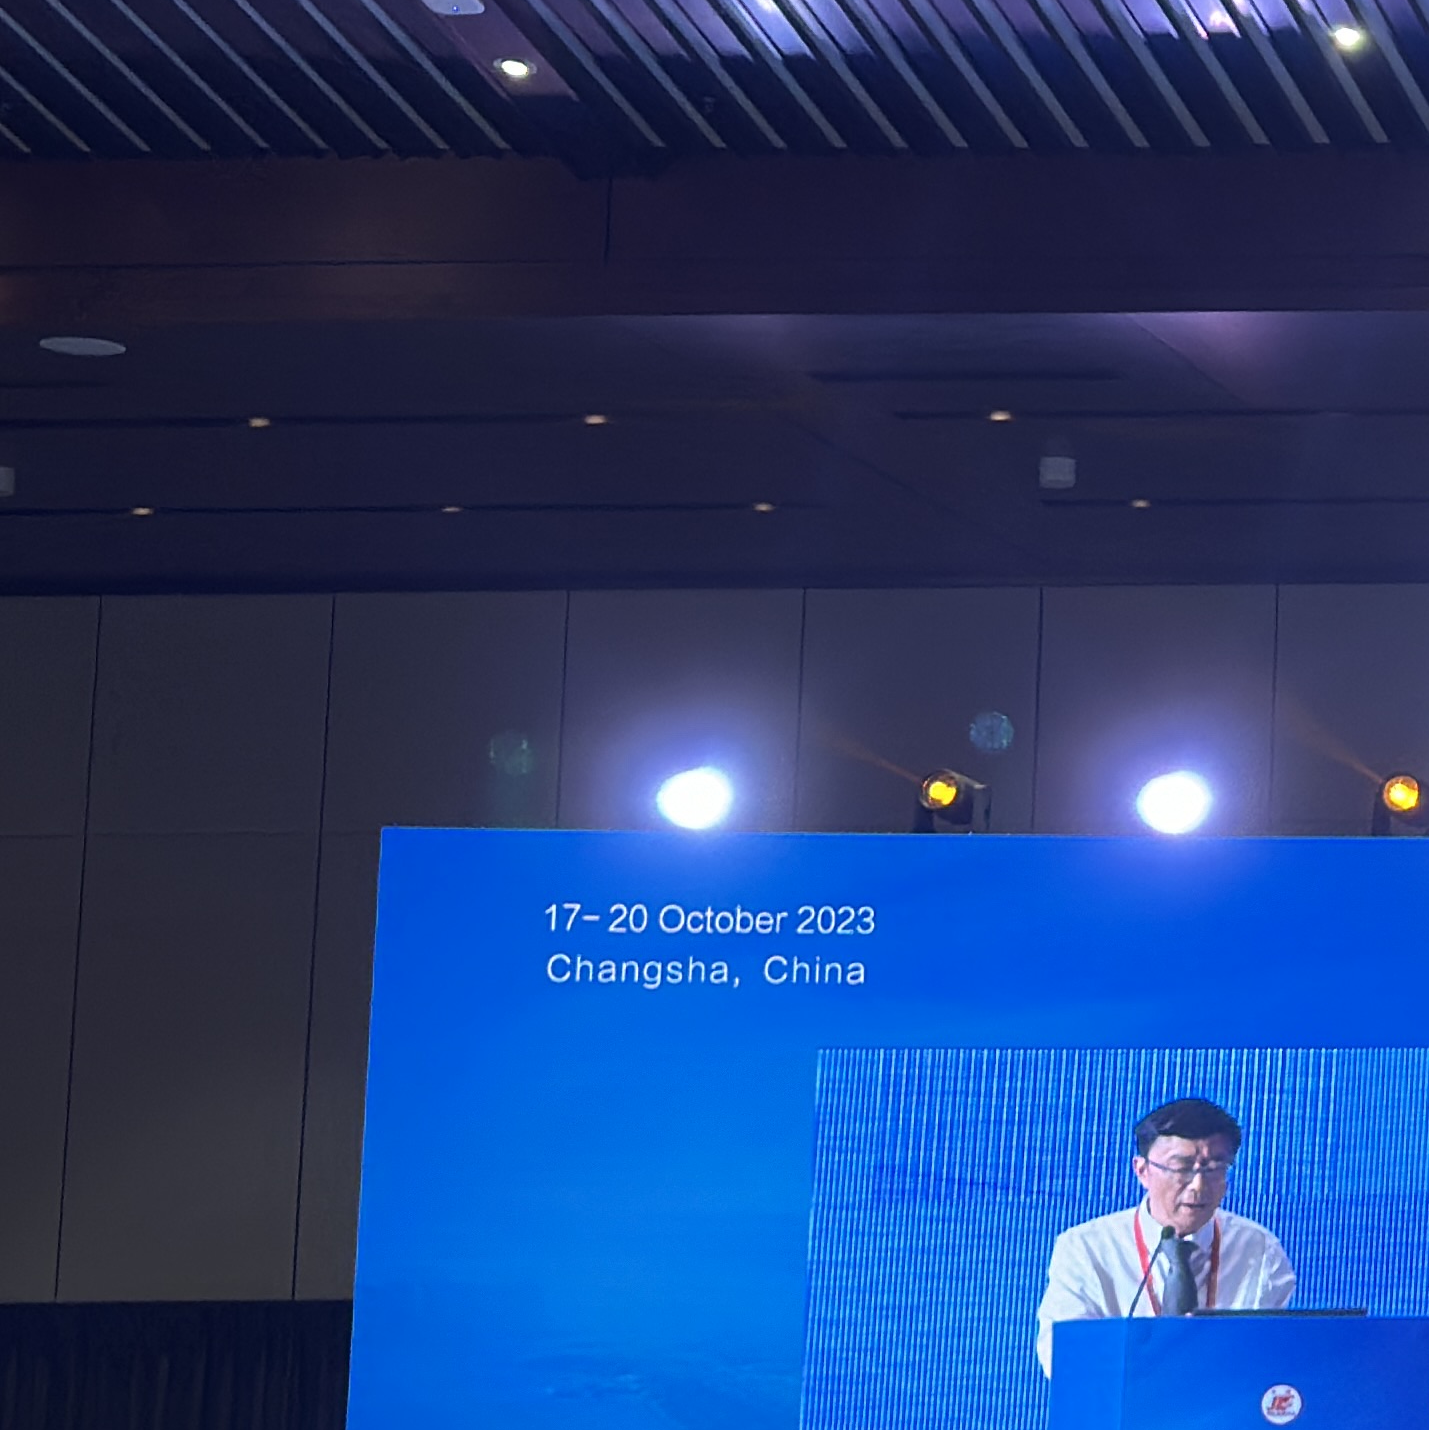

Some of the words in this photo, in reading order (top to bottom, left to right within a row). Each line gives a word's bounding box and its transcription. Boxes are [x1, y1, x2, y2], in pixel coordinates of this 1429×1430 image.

[659, 904, 788, 934] October
[796, 905, 876, 935] 2023
[547, 953, 740, 990] Changsha,
[763, 955, 865, 985] China
